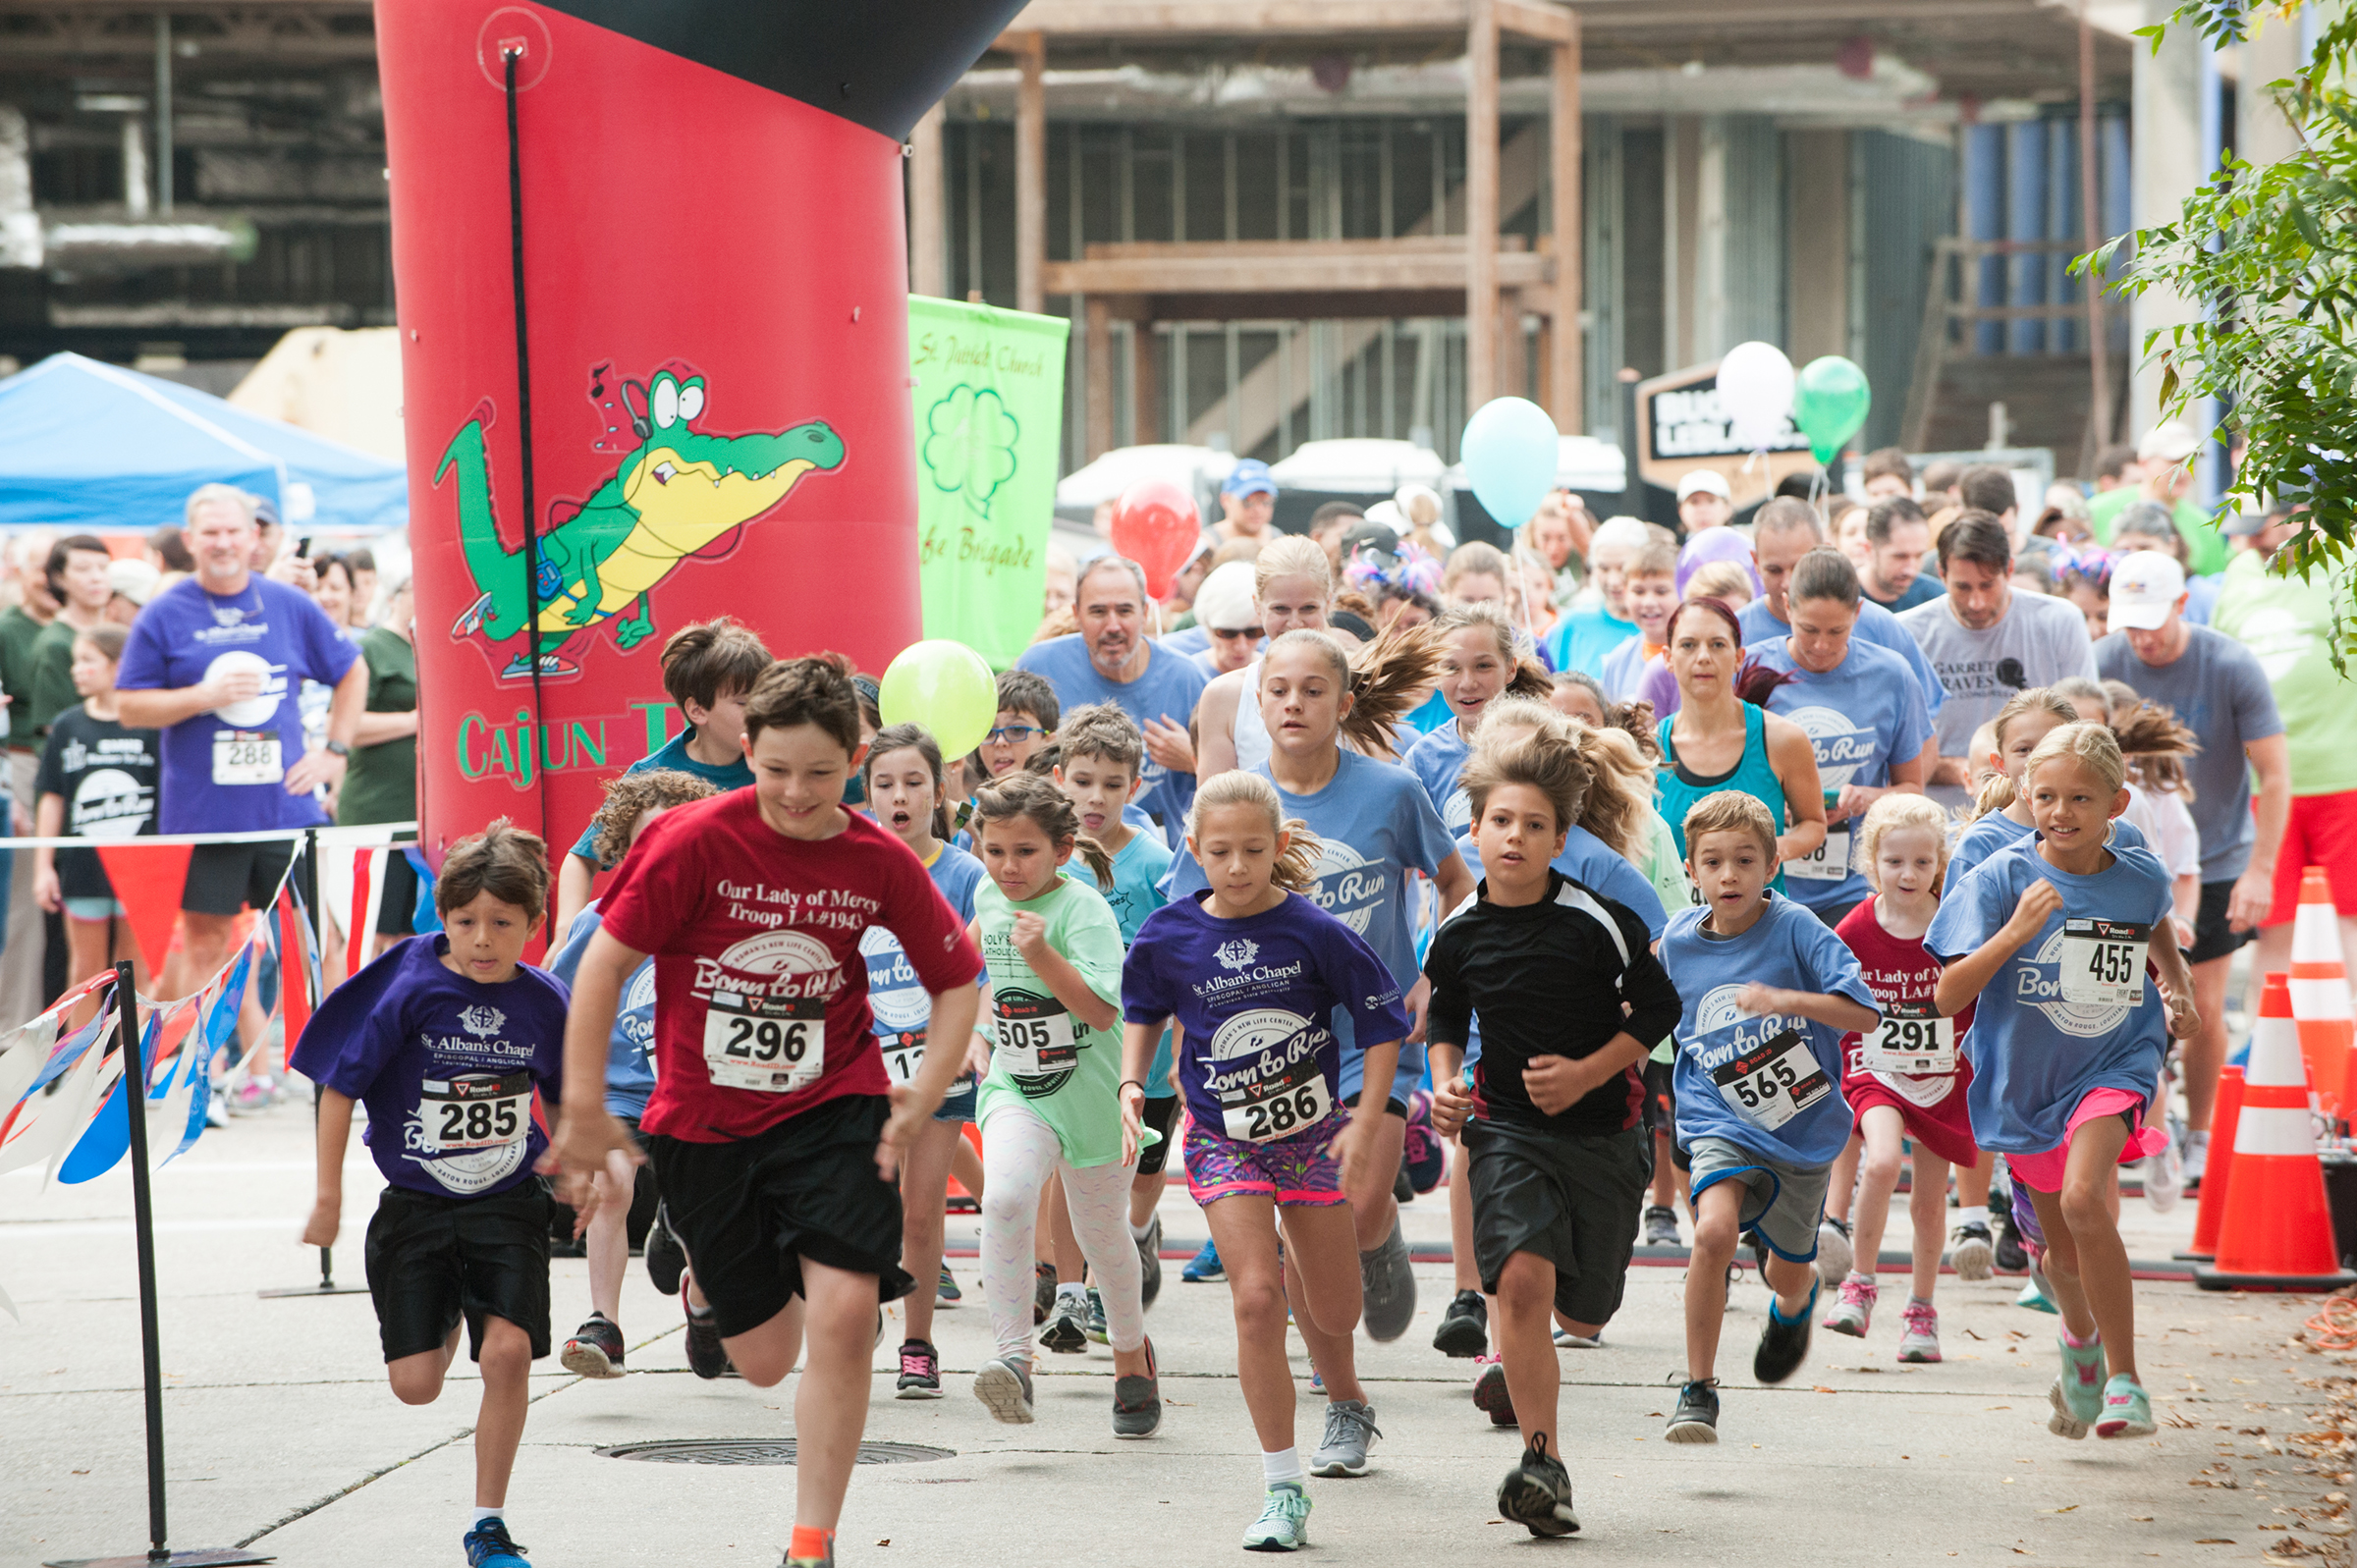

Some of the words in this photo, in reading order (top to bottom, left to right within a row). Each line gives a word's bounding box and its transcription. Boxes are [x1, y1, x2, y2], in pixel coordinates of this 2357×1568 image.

[958, 527, 1033, 576] Brigade
[1942, 675, 1994, 690] RAVES
[229, 742, 272, 766] 288
[1831, 736, 1876, 761] Run
[717, 879, 752, 900] Our
[755, 884, 801, 908] Lady
[805, 889, 827, 906] of
[829, 889, 882, 915] Mercy
[1339, 871, 1385, 904] Run
[727, 901, 784, 929] Troop
[1205, 972, 1251, 994] Alban's
[1252, 959, 1302, 980] Chapel
[1860, 969, 1874, 981] ur
[1875, 968, 1911, 986] Lady
[1913, 969, 1928, 982] of
[2088, 943, 2134, 984] 455
[1251, 979, 1290, 991] ANGLICAN
[1870, 987, 1898, 1001] roop
[996, 1019, 1051, 1050] 505
[1237, 1020, 1252, 1030] NEW
[1269, 1016, 1294, 1028] CENTER
[1881, 1020, 1940, 1051] 291
[437, 1036, 491, 1054] Alban's
[725, 1016, 807, 1062] 296
[1733, 1025, 1760, 1055] to
[433, 1053, 479, 1062] EPISCOPAL
[486, 1056, 526, 1066] ANGLICAN
[1258, 1049, 1286, 1078] to
[1732, 1056, 1797, 1108] 565
[439, 1098, 518, 1141] 285
[1245, 1085, 1318, 1140] 286
